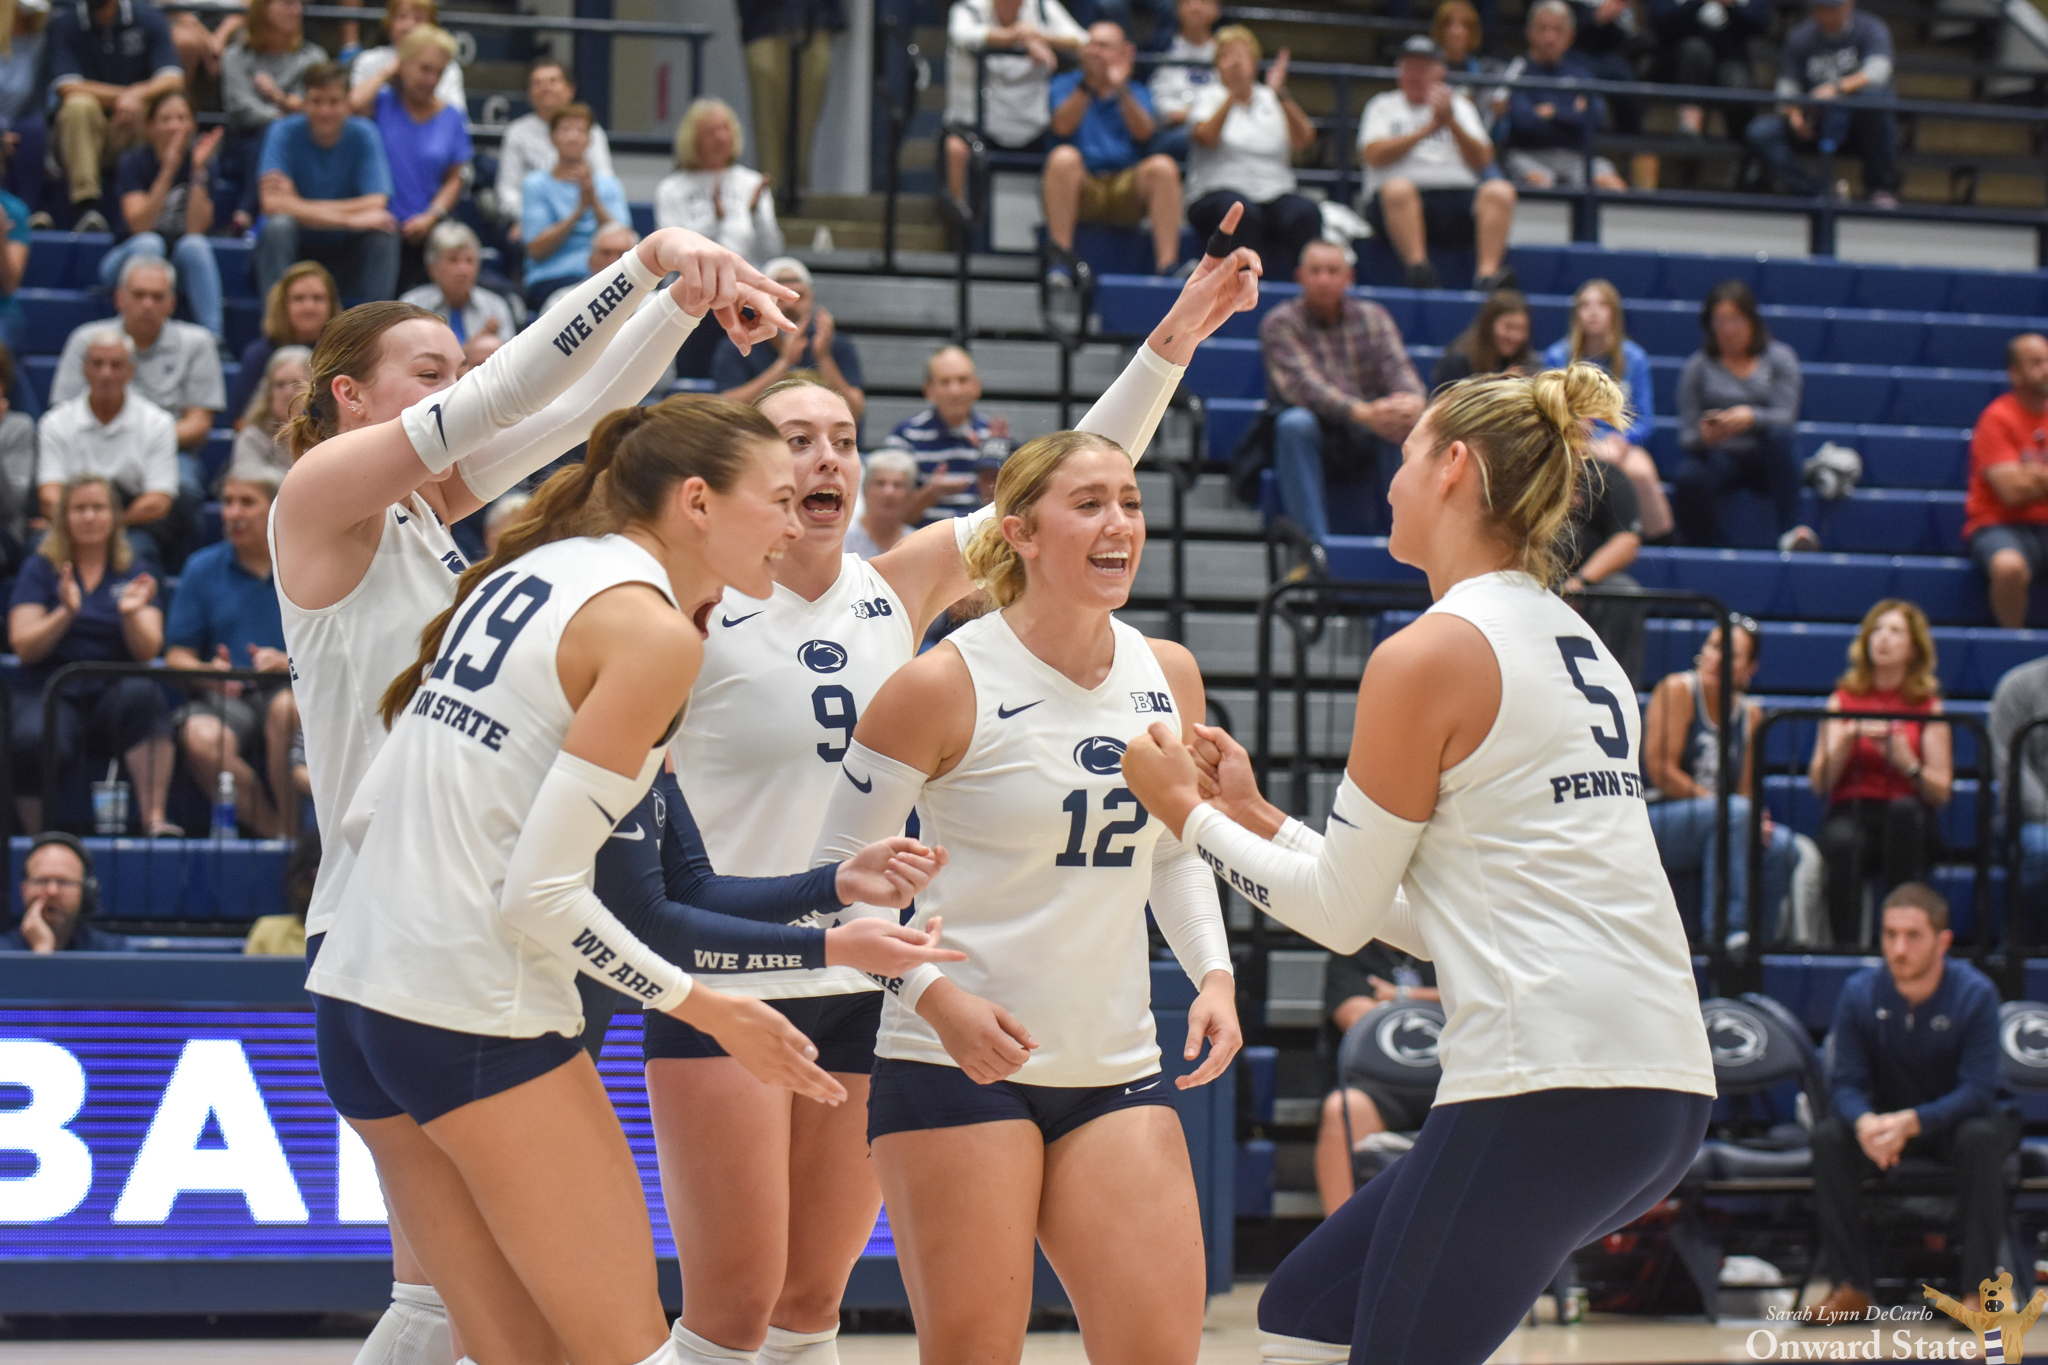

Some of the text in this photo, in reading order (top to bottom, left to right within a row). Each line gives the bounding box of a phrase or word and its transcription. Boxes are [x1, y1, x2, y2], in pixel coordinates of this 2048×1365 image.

[552, 272, 634, 357] WE ARE
[430, 571, 553, 692] 19
[431, 694, 510, 752] STATE
[811, 684, 857, 763] 9
[1555, 635, 1629, 760] 5
[1549, 770, 1621, 804] PENN
[1054, 787, 1150, 867] 12
[1197, 843, 1272, 909] WE ARE
[572, 927, 664, 999] WE ARE
[694, 949, 802, 970] WE ARE
